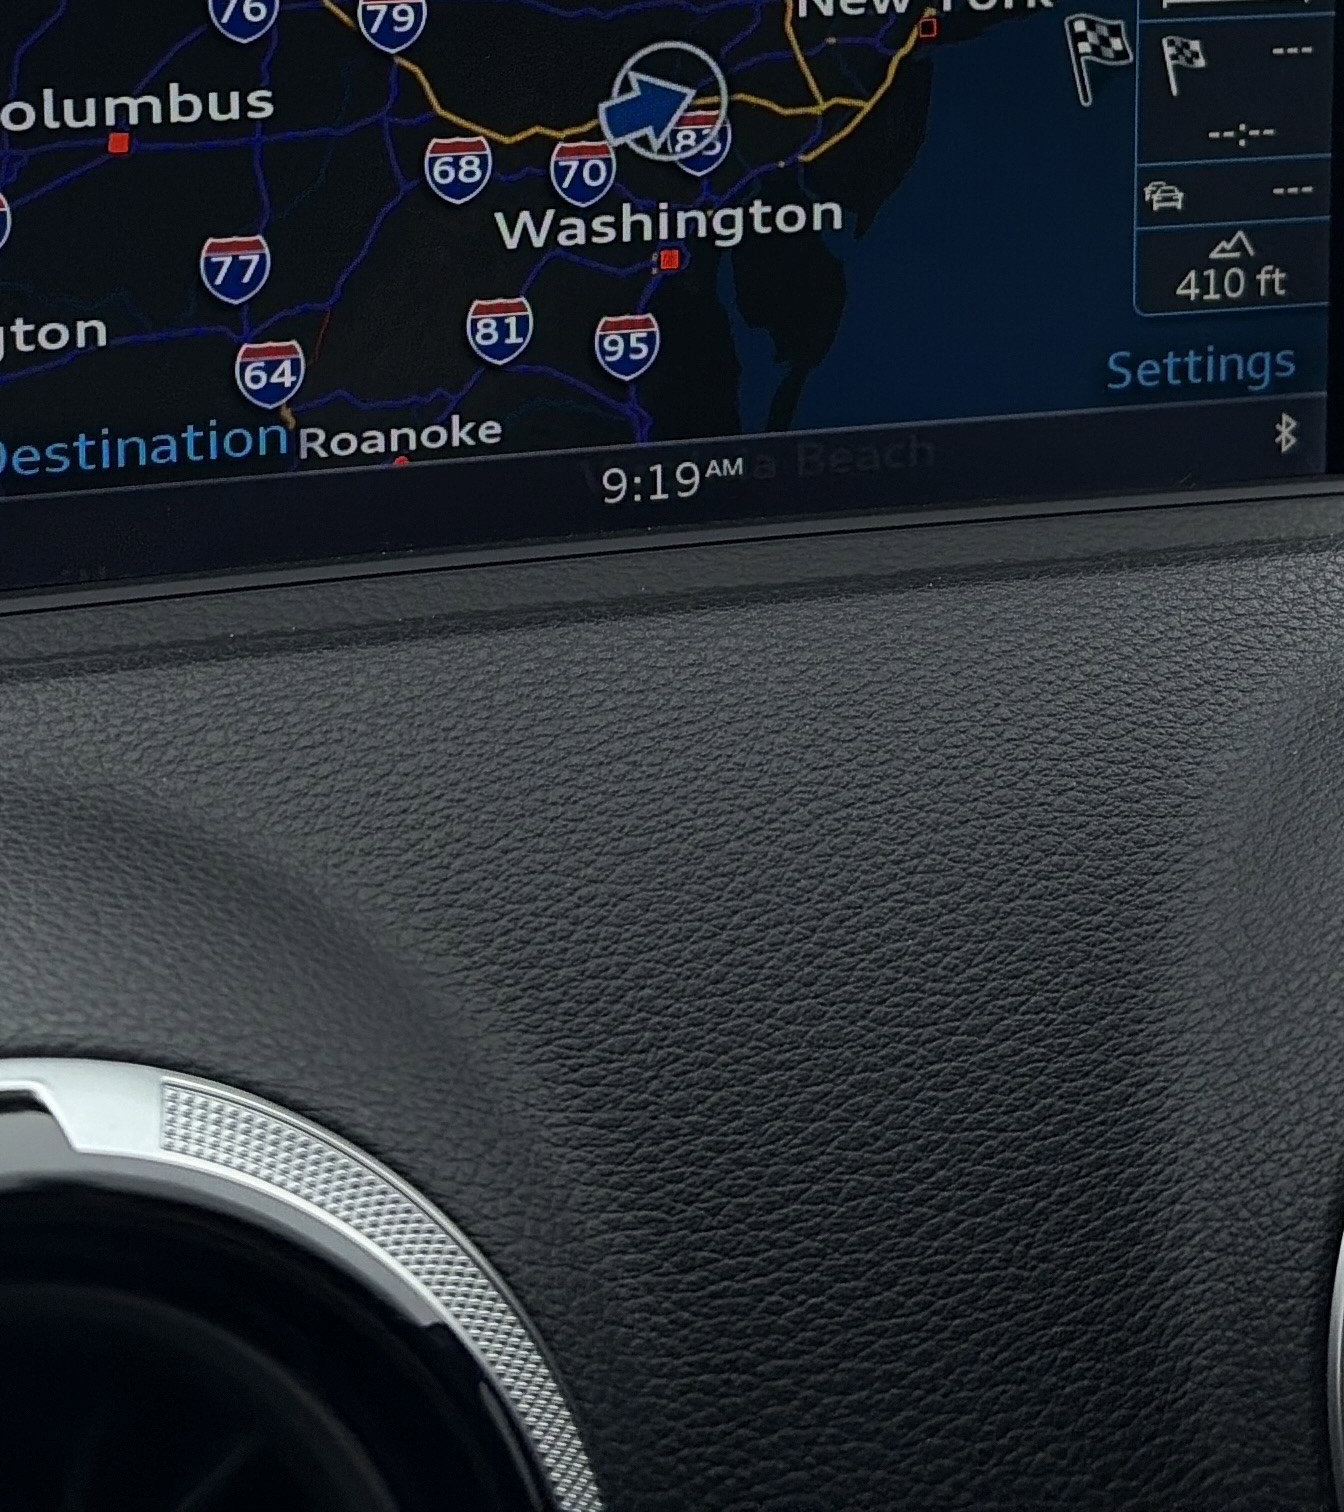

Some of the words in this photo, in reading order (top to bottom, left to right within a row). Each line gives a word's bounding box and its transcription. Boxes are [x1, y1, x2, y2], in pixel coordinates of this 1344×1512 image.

[366, 3, 415, 35] 79
[432, 155, 482, 185] 68
[558, 158, 607, 190] 70
[493, 197, 844, 250] Washington
[210, 254, 260, 287] 77
[1175, 267, 1245, 302] 410
[1255, 264, 1287, 297] ft
[474, 315, 524, 346] 81
[603, 331, 652, 362] 95
[244, 358, 297, 390] 64
[1107, 345, 1297, 391] Settings
[299, 413, 503, 460] Roanoke
